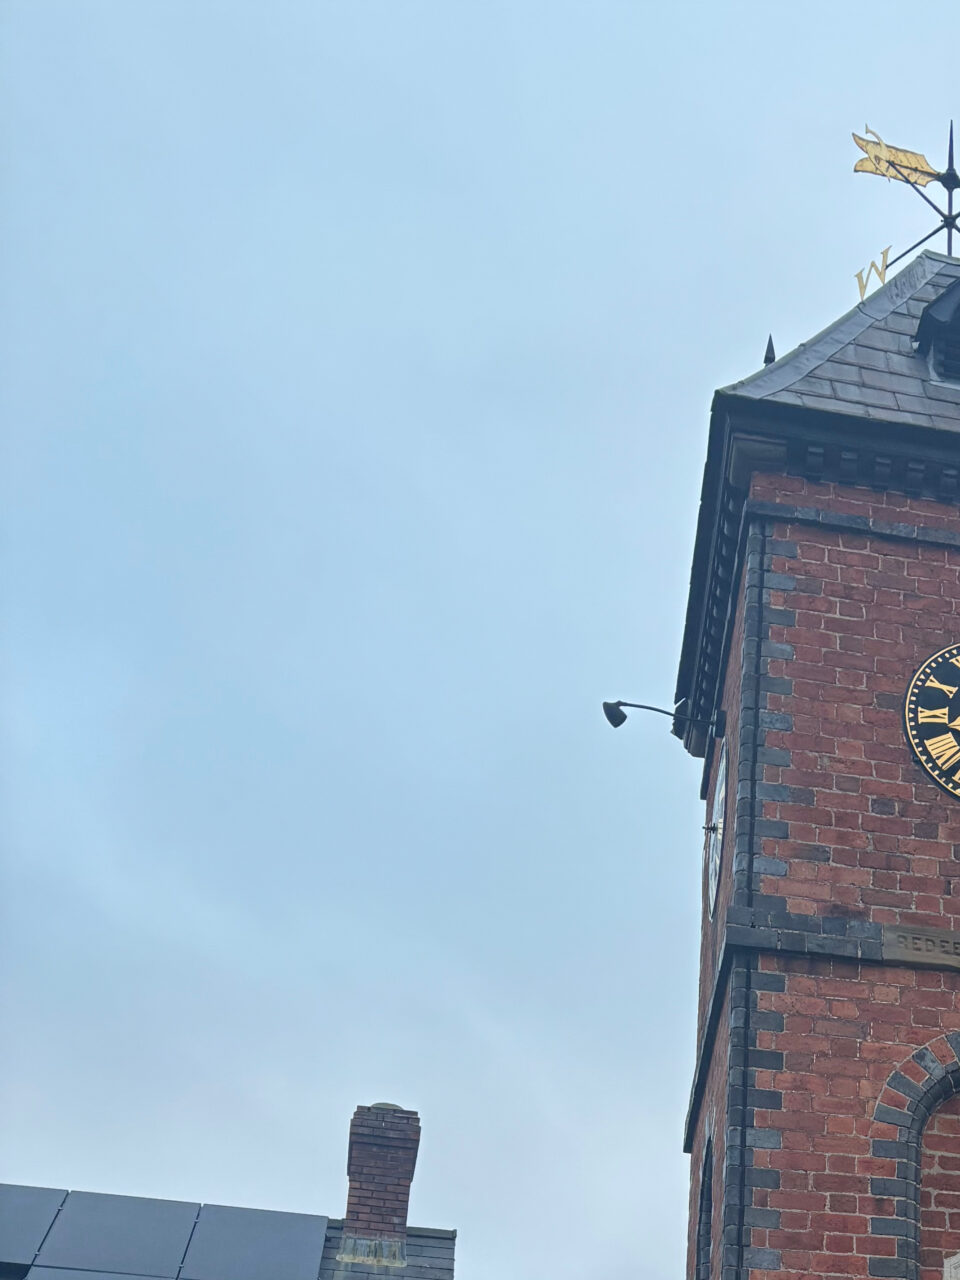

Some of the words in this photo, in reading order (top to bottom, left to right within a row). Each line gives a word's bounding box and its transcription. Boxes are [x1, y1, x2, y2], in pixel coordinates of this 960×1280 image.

[854, 245, 892, 303] W
[925, 675, 959, 699] X
[918, 706, 949, 724] IX
[924, 731, 960, 767] VIII
